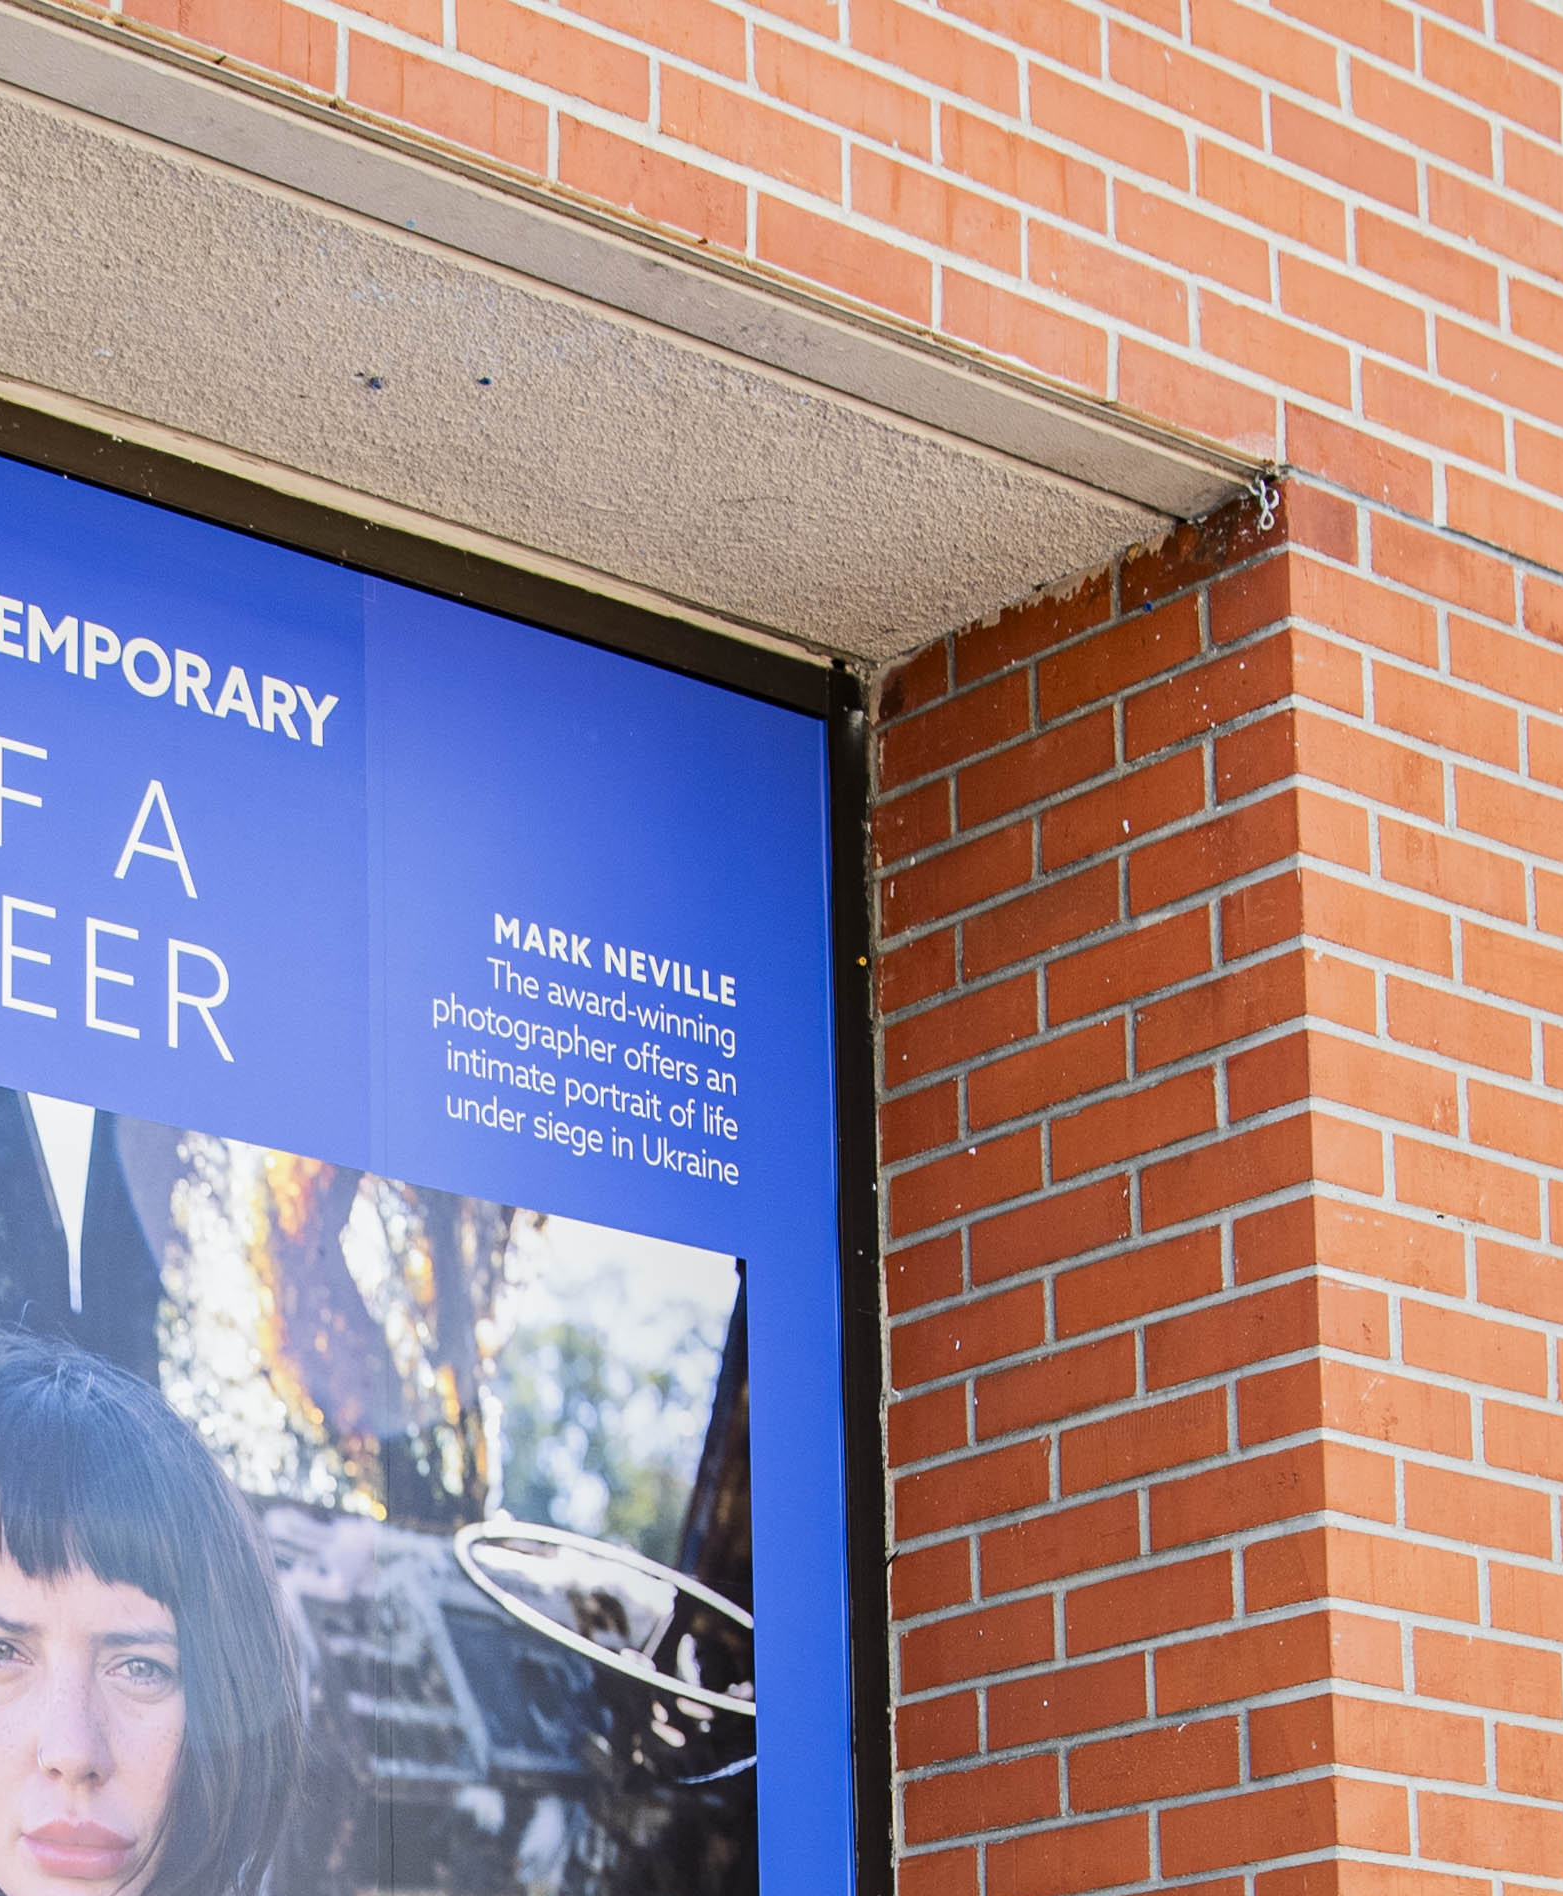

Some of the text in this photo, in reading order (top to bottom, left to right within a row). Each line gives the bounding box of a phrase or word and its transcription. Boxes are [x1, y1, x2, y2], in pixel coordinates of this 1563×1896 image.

[114, 780, 197, 899] A
[487, 957, 736, 1059] The award-winning
[494, 913, 736, 1007] MARK NEVILLE
[433, 992, 737, 1096] photographer offers an
[447, 1041, 738, 1140] intimate portrait of life
[447, 1095, 739, 1185] under siege in Ukraine
